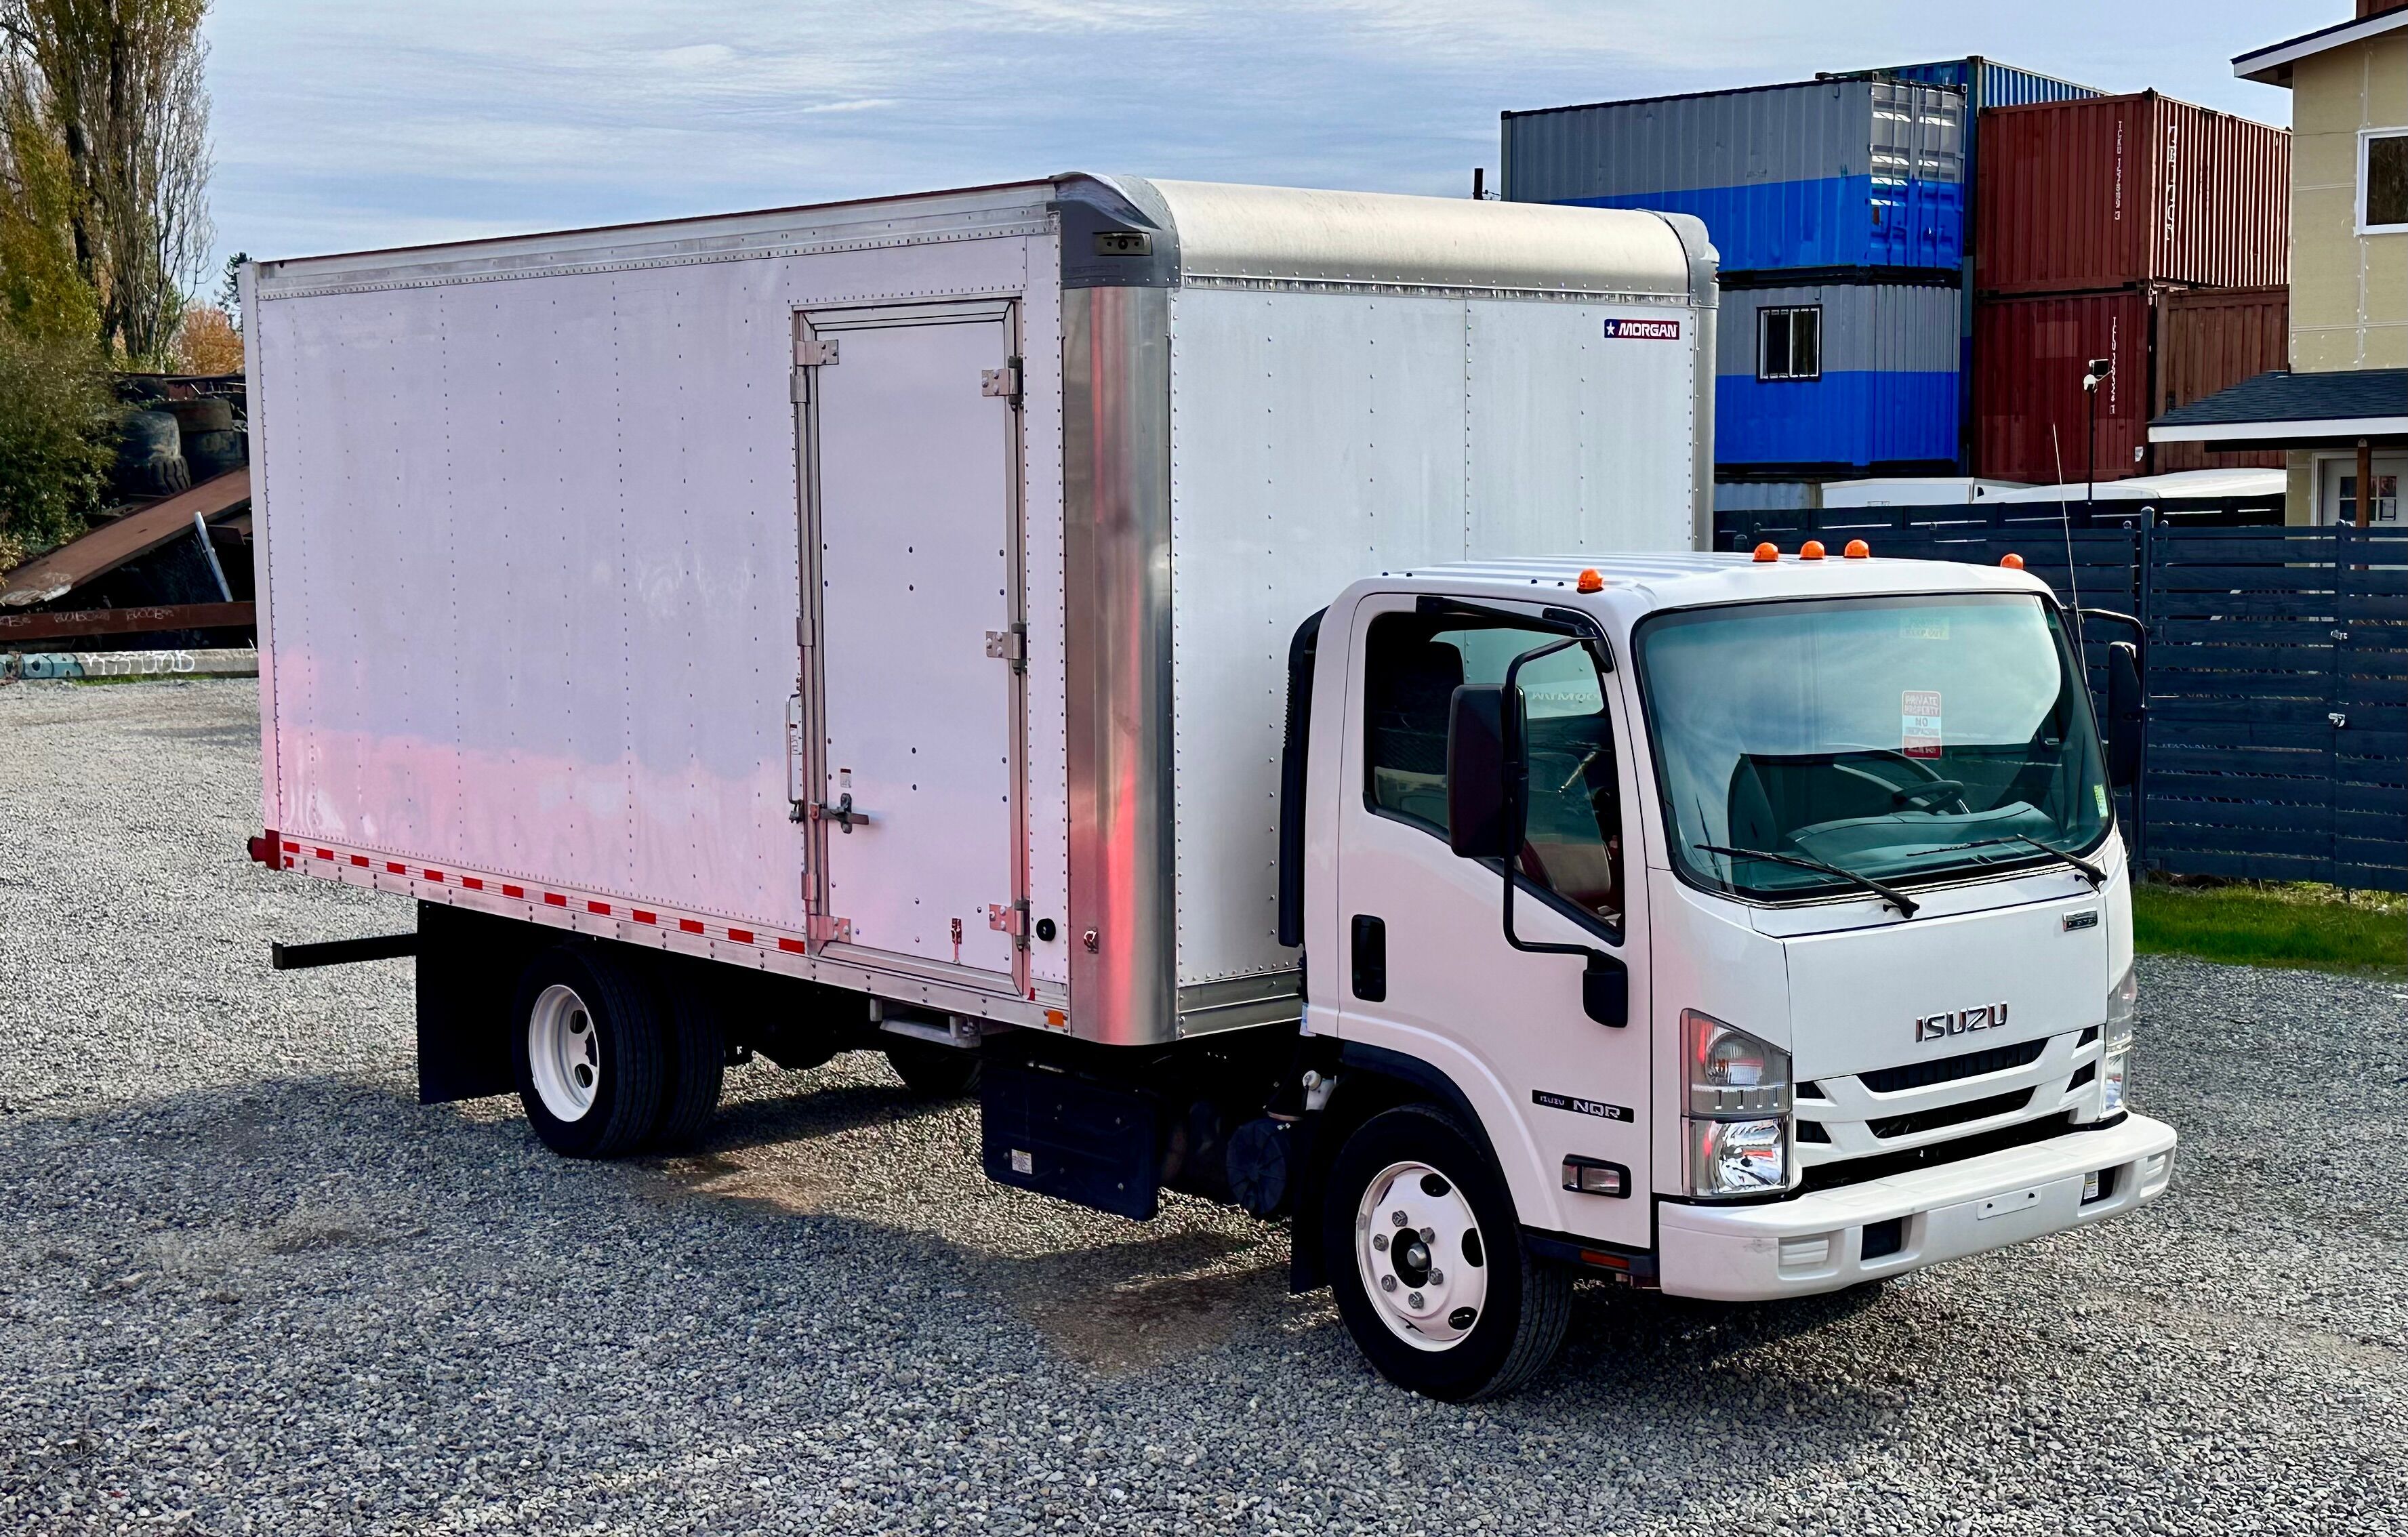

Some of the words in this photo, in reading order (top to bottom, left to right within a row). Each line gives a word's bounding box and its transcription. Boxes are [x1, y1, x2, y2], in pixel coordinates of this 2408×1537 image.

[1618, 323, 1677, 337] MORGAN
[1904, 694, 1938, 706] PRIVATE
[1915, 717, 1928, 727] NO
[1916, 1000, 2007, 1043] ISUZU
[1540, 1095, 1565, 1106] ISUZU
[1573, 1099, 1620, 1118] NQR
